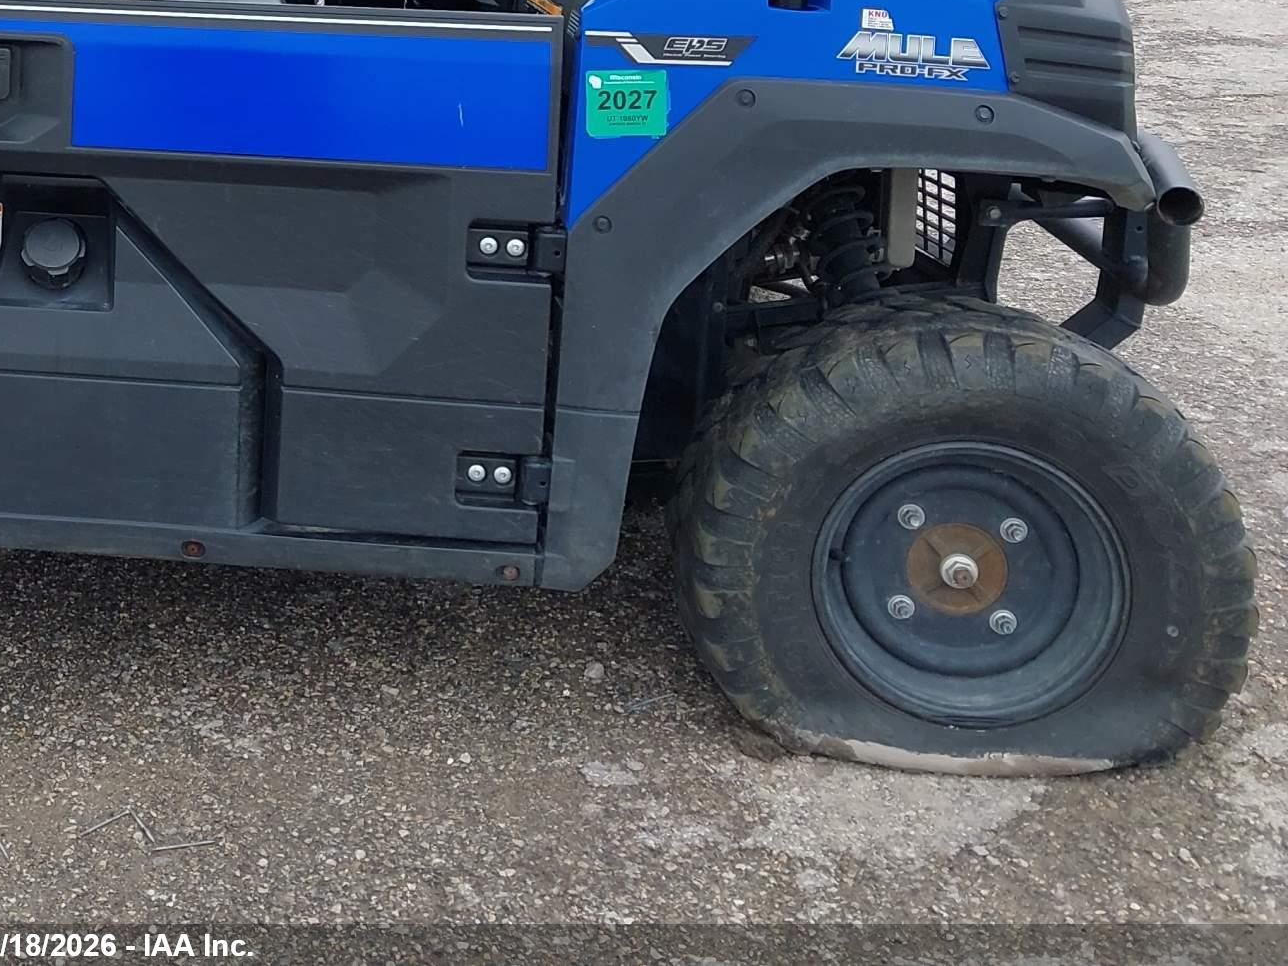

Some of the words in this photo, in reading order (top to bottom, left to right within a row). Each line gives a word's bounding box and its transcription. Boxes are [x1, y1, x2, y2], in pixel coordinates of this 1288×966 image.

[664, 37, 728, 54] EPS
[836, 31, 991, 69] MULE
[856, 61, 968, 81] PRO-FX
[598, 90, 657, 110] 2027
